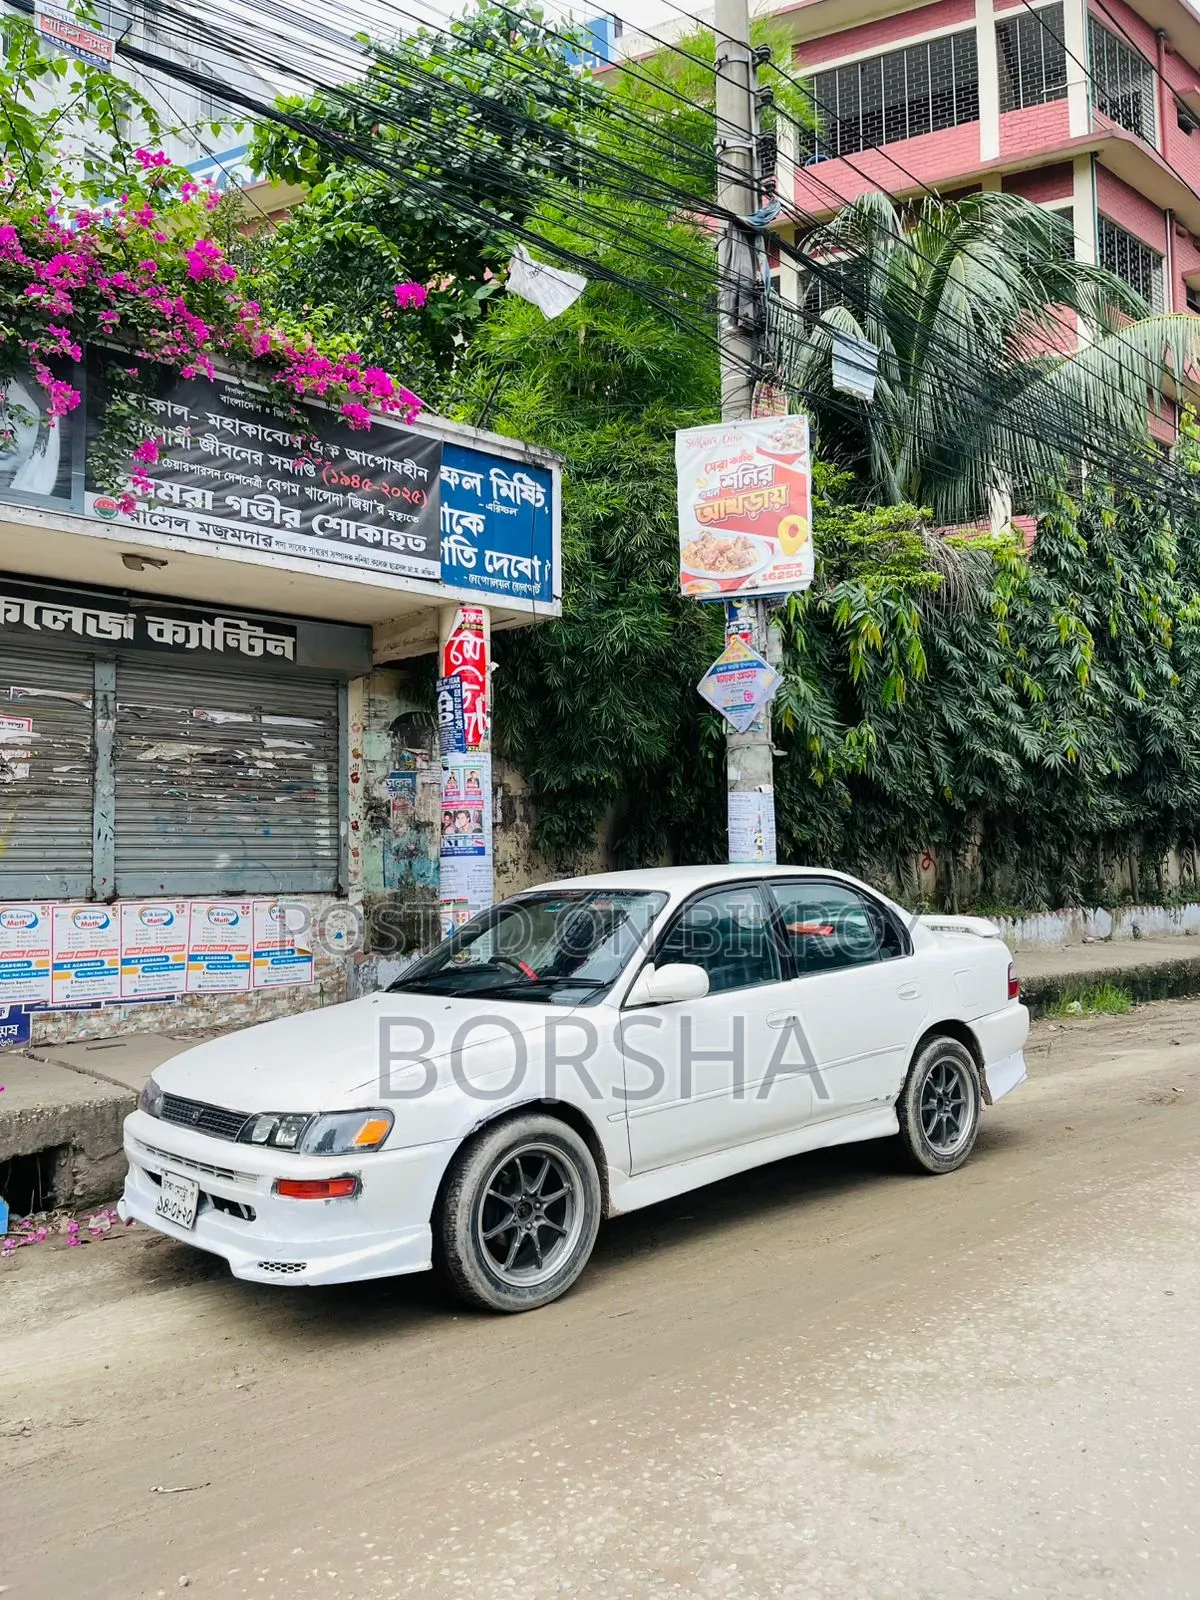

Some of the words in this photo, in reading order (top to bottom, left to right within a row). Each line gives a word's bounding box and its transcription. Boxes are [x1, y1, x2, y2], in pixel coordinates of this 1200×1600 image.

[198, 433, 263, 466] জীবনের
[322, 466, 429, 510] (১৯৪৫-২০২৫)
[345, 447, 429, 482] আপোষহীন
[267, 478, 300, 497] বেগম
[304, 485, 343, 507] খালেদা
[129, 509, 191, 532] রাসেল
[225, 493, 302, 529] গভীর
[311, 514, 427, 552] শোকাহত
[145, 616, 296, 661] ক্যান্টিন
